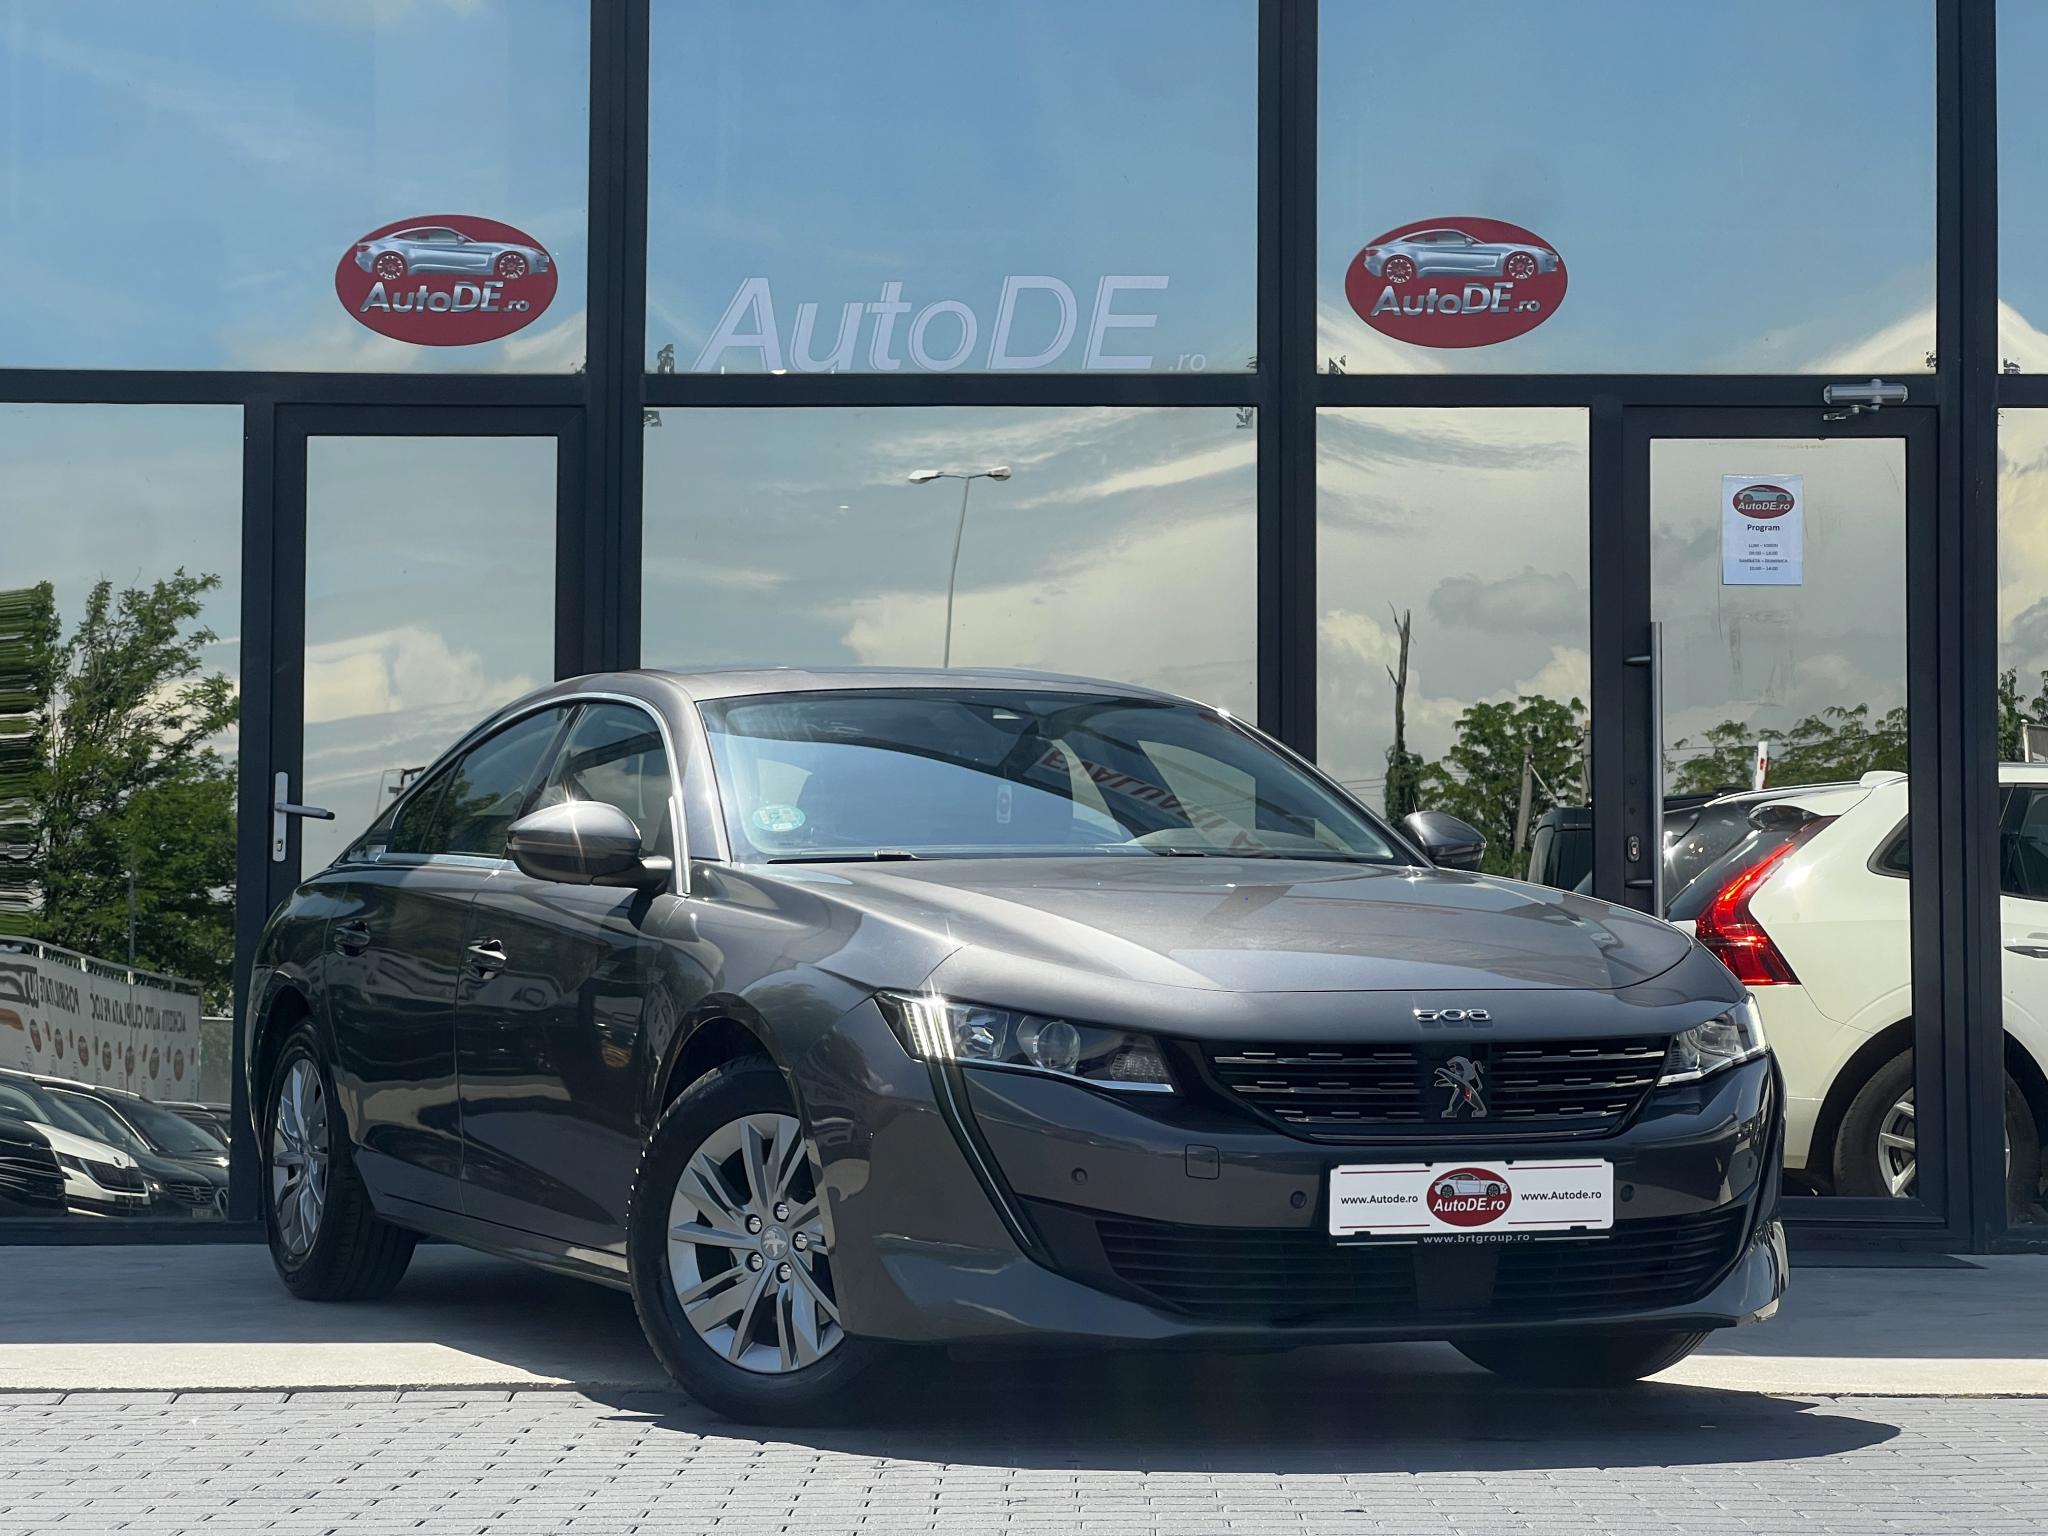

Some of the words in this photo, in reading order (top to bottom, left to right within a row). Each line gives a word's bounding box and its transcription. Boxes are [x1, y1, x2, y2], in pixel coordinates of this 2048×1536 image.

[1737, 501, 1791, 511] AutoDE.ro
[1747, 523, 1781, 533] Program
[1413, 1008, 1491, 1022] 508
[1340, 1193, 1419, 1205] www.Autode.ro
[1520, 1189, 1603, 1202] www.Autode.ro
[1432, 1197, 1507, 1214] AutoDE.ro
[1422, 1232, 1531, 1245] www.brtgroup.ro
